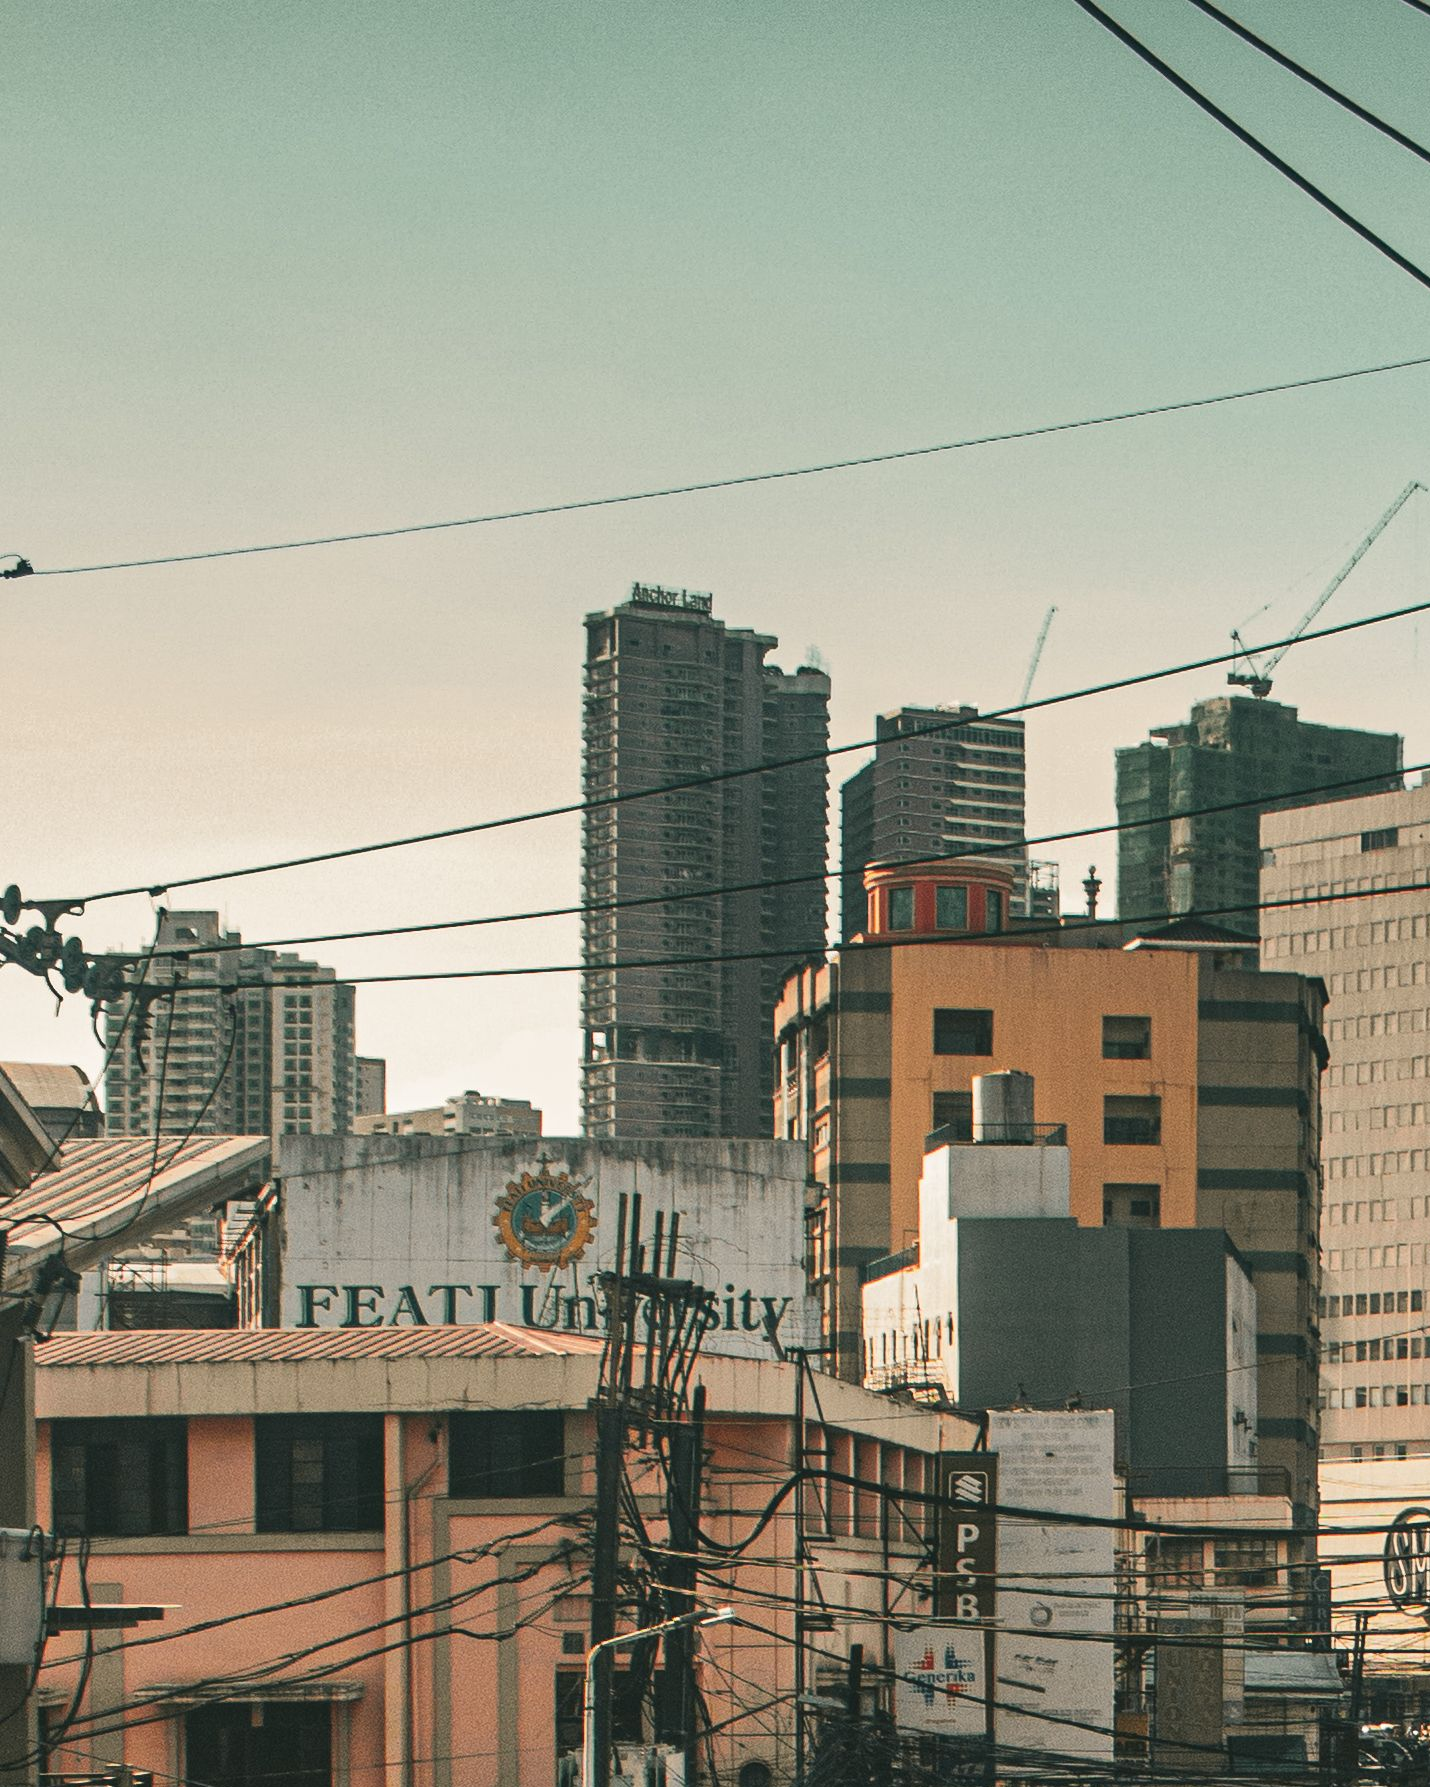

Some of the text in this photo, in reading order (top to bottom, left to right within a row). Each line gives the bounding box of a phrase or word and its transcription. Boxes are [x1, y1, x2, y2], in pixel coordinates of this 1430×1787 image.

[632, 582, 713, 612] Anchor Land
[296, 1285, 502, 1328] FEATI
[904, 1669, 977, 1688] Generika
